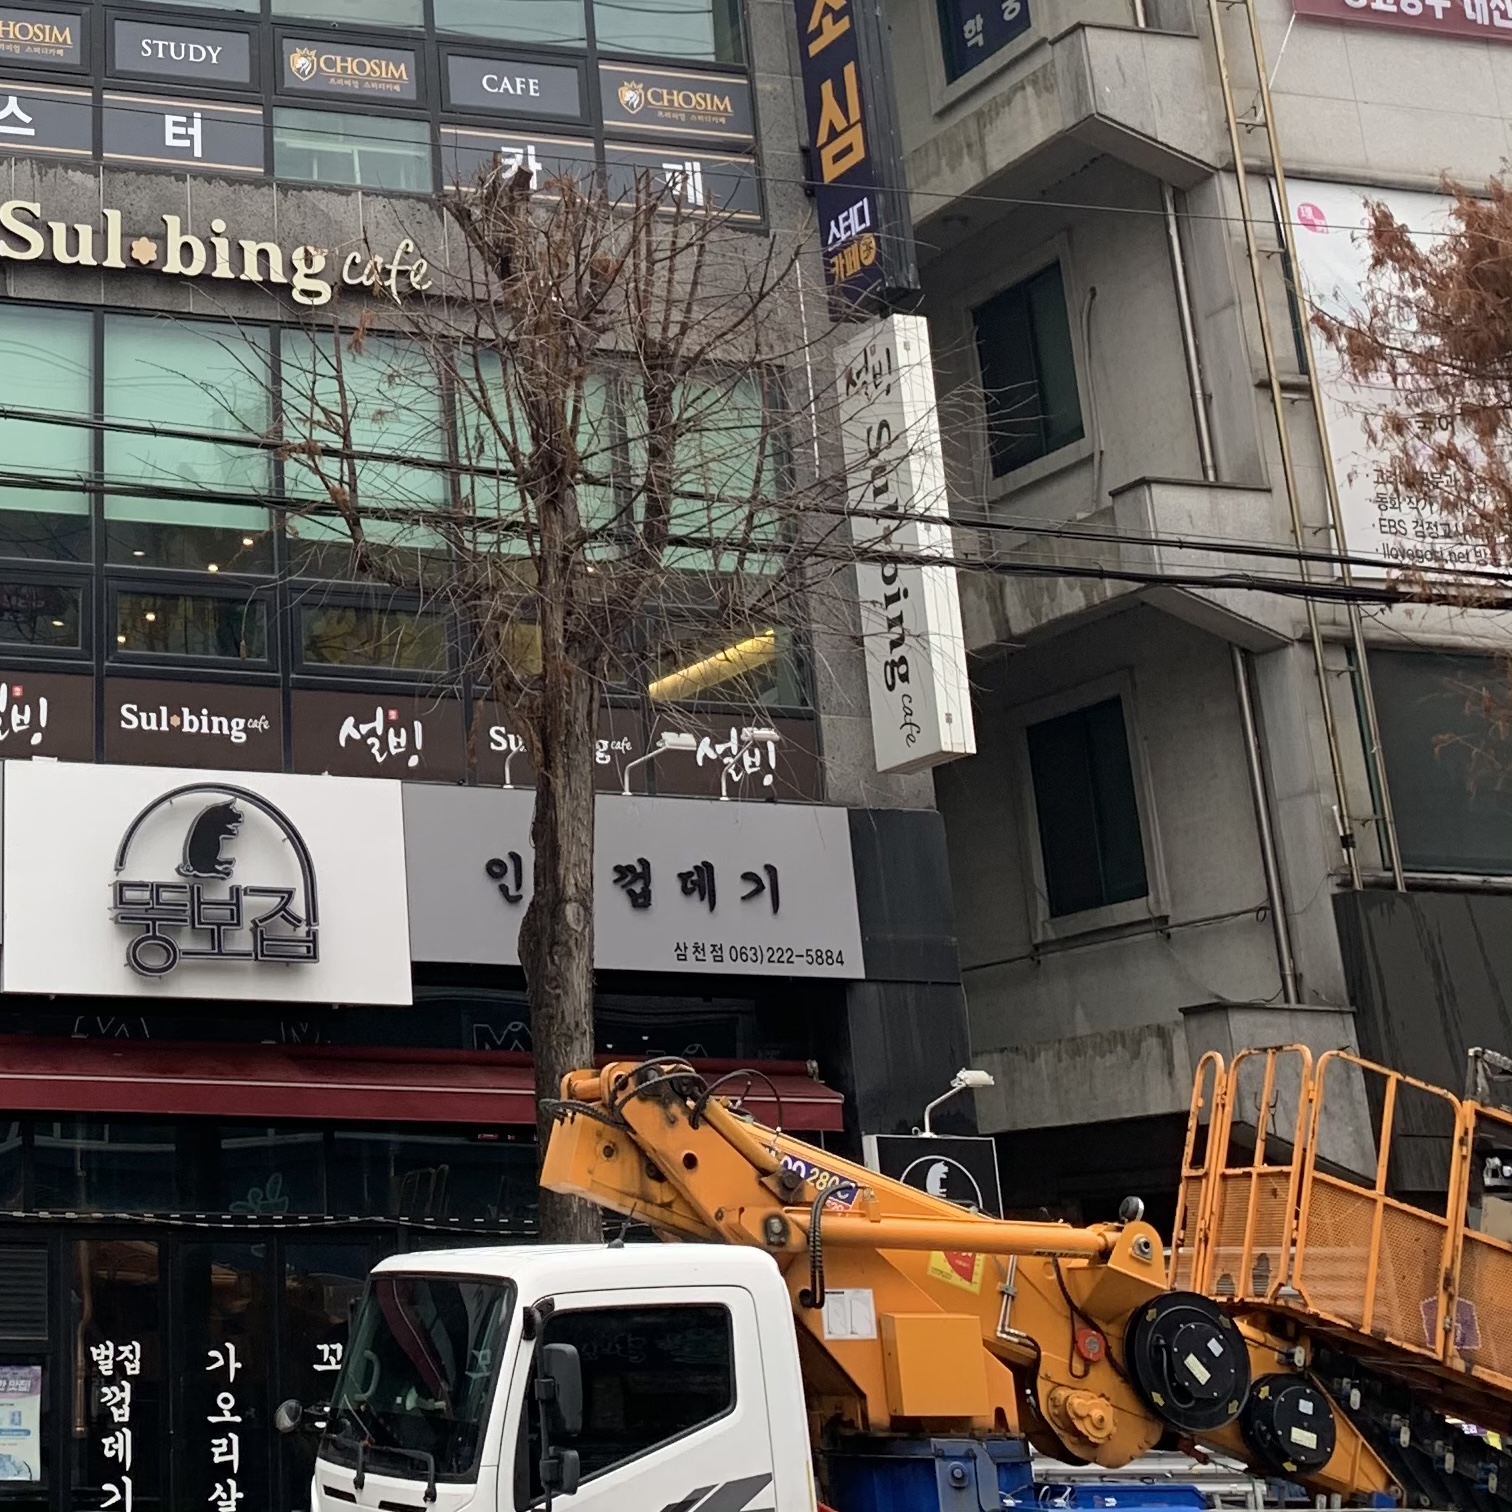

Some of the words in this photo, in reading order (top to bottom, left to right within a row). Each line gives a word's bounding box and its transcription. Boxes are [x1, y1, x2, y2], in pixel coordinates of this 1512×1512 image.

[140, 38, 223, 64] STUDY
[319, 54, 409, 80] CHOSIM
[481, 73, 541, 97] CAFE
[647, 87, 733, 113] CHOSIM
[828, 196, 871, 252] 스터디
[342, 238, 433, 305] cafe
[1379, 517, 1408, 536] EBS
[247, 715, 271, 730] cafe
[339, 706, 424, 768] 설빙
[611, 737, 632, 751] cafe
[901, 694, 918, 748] cafe
[108, 880, 320, 977] 뚱보집
[673, 939, 725, 964] 삼천점
[727, 944, 846, 969] 063)222-5884
[89, 1340, 142, 1376] 벌집
